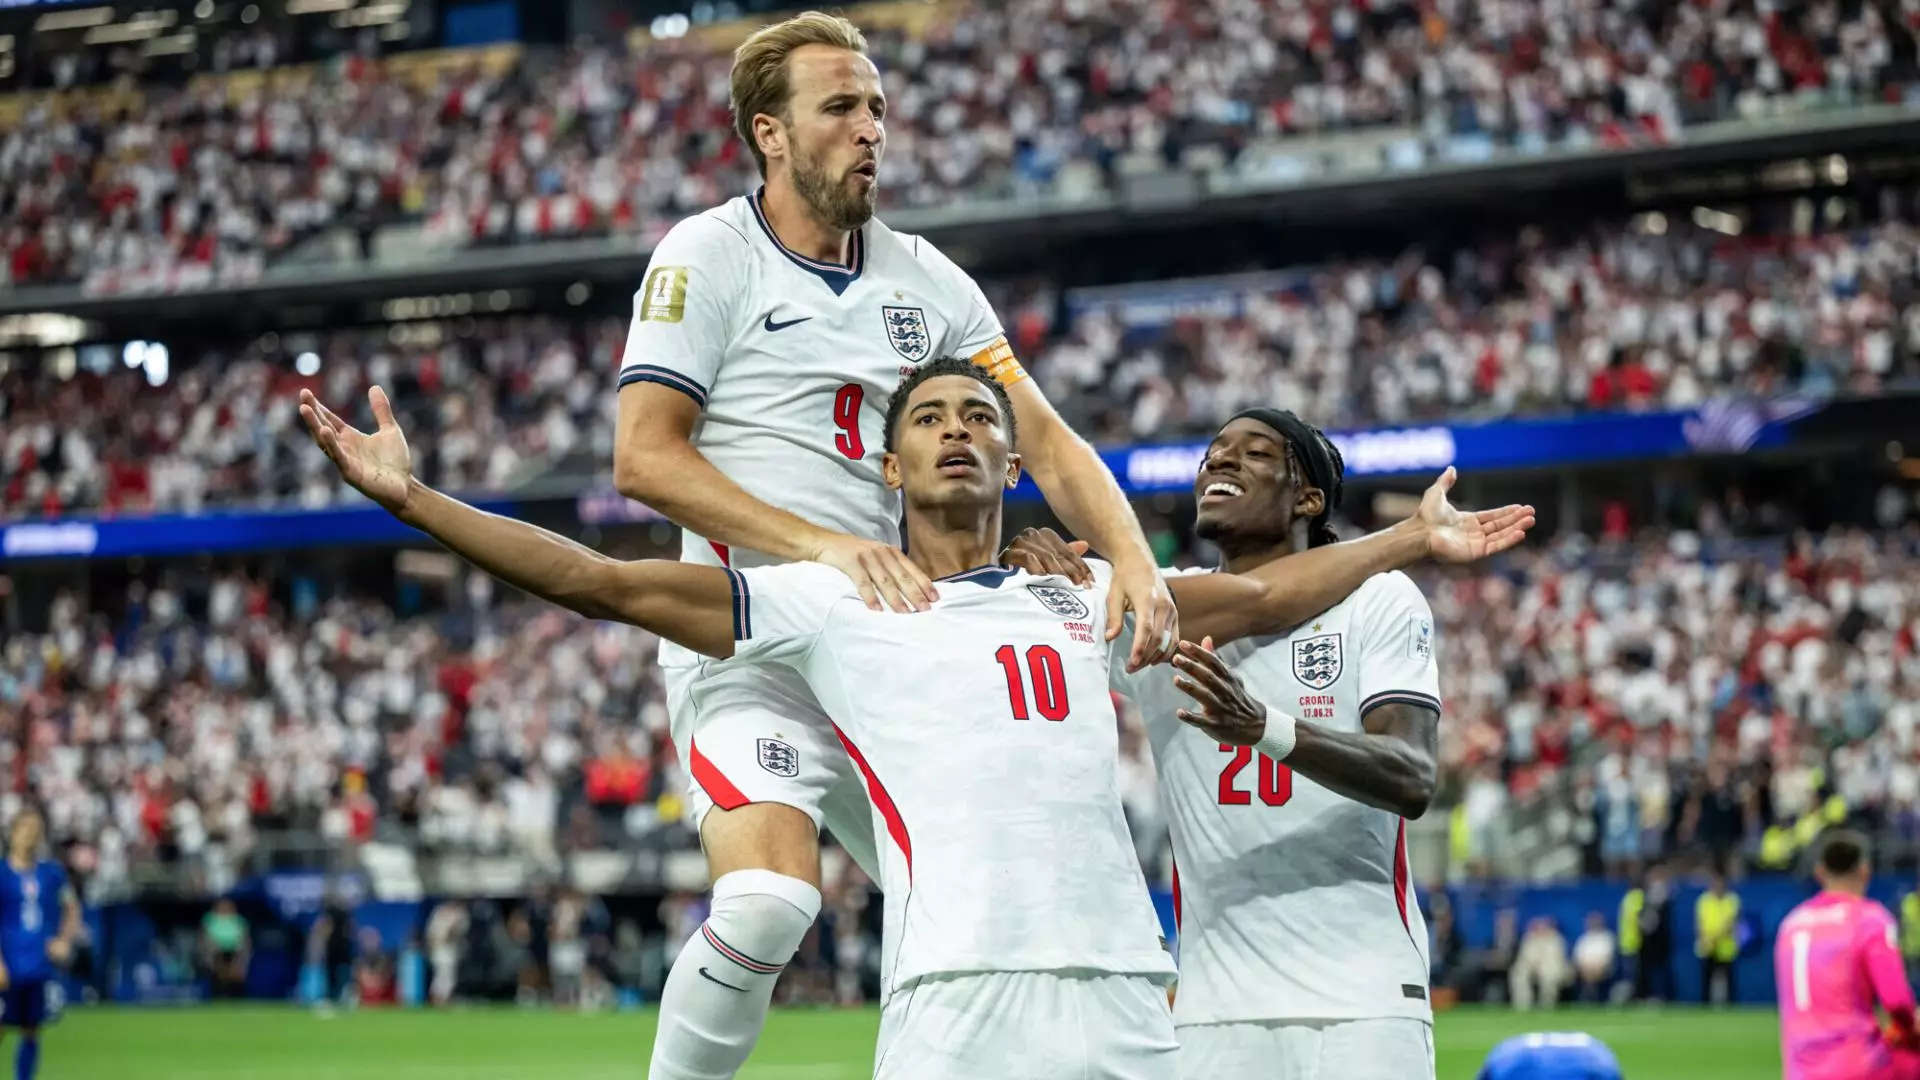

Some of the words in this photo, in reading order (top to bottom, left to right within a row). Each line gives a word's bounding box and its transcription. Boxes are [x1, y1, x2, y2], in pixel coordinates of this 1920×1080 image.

[834, 383, 865, 461] 9
[995, 644, 1070, 721] 10
[1299, 696, 1334, 706] CROATIA
[1303, 707, 1334, 718] 17.06.26
[1218, 743, 1292, 806] 20
[1792, 931, 1810, 1011] 1
